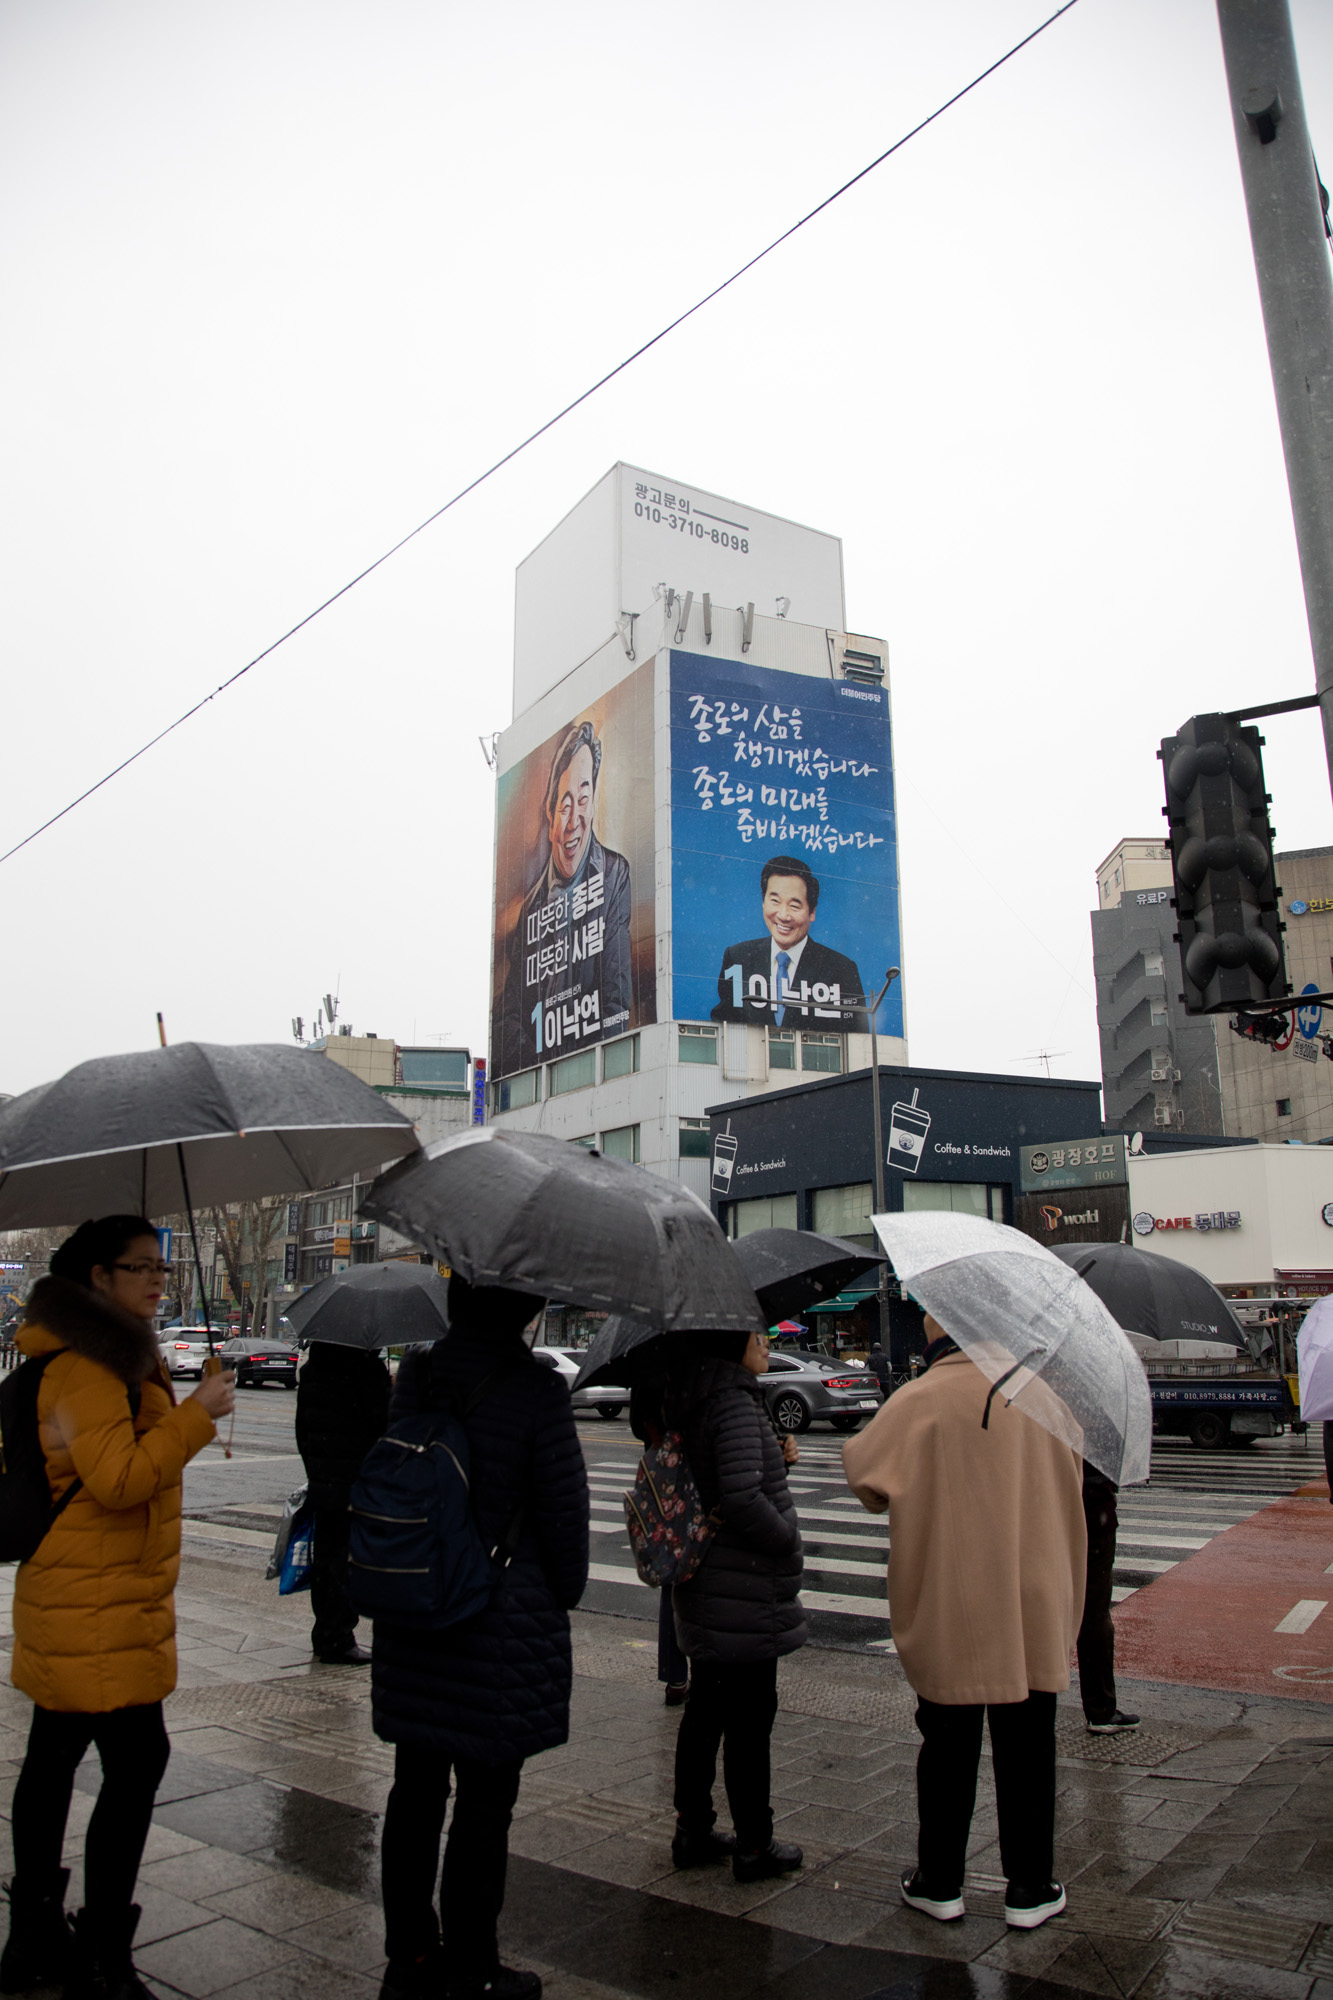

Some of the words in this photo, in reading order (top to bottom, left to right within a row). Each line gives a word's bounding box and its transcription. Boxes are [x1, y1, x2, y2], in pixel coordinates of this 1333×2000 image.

[635, 482, 690, 515] 광고문의
[634, 502, 749, 554] 010-3710-8098
[841, 687, 881, 703] 더불어민주당
[688, 694, 749, 743] 종로의
[754, 704, 803, 740] 삶을
[733, 731, 879, 780] 챙기겠습니다
[692, 766, 754, 810] 종로의
[761, 784, 829, 821] 미래를
[736, 808, 884, 853] 준비하겠습니다
[527, 892, 570, 946] 따뜻한
[571, 871, 605, 921] 종로
[1136, 891, 1167, 905] 유료P
[526, 935, 570, 987] 따뜻한
[571, 916, 606, 964] 사람
[748, 973, 842, 1019] 이낙연
[544, 989, 601, 1049] 이낙연
[736, 1164, 753, 1175] Coffee
[754, 1163, 759, 1172] &
[760, 1158, 786, 1171] Sandwich
[934, 1142, 962, 1154] Coffee
[963, 1144, 971, 1155] &
[972, 1145, 1011, 1157] Sandwich
[1051, 1143, 1117, 1168] 광장호프
[1094, 1169, 1118, 1181] HOF
[1063, 1209, 1099, 1226] world
[1155, 1217, 1193, 1231] CAFE
[1194, 1211, 1242, 1232] 동대문
